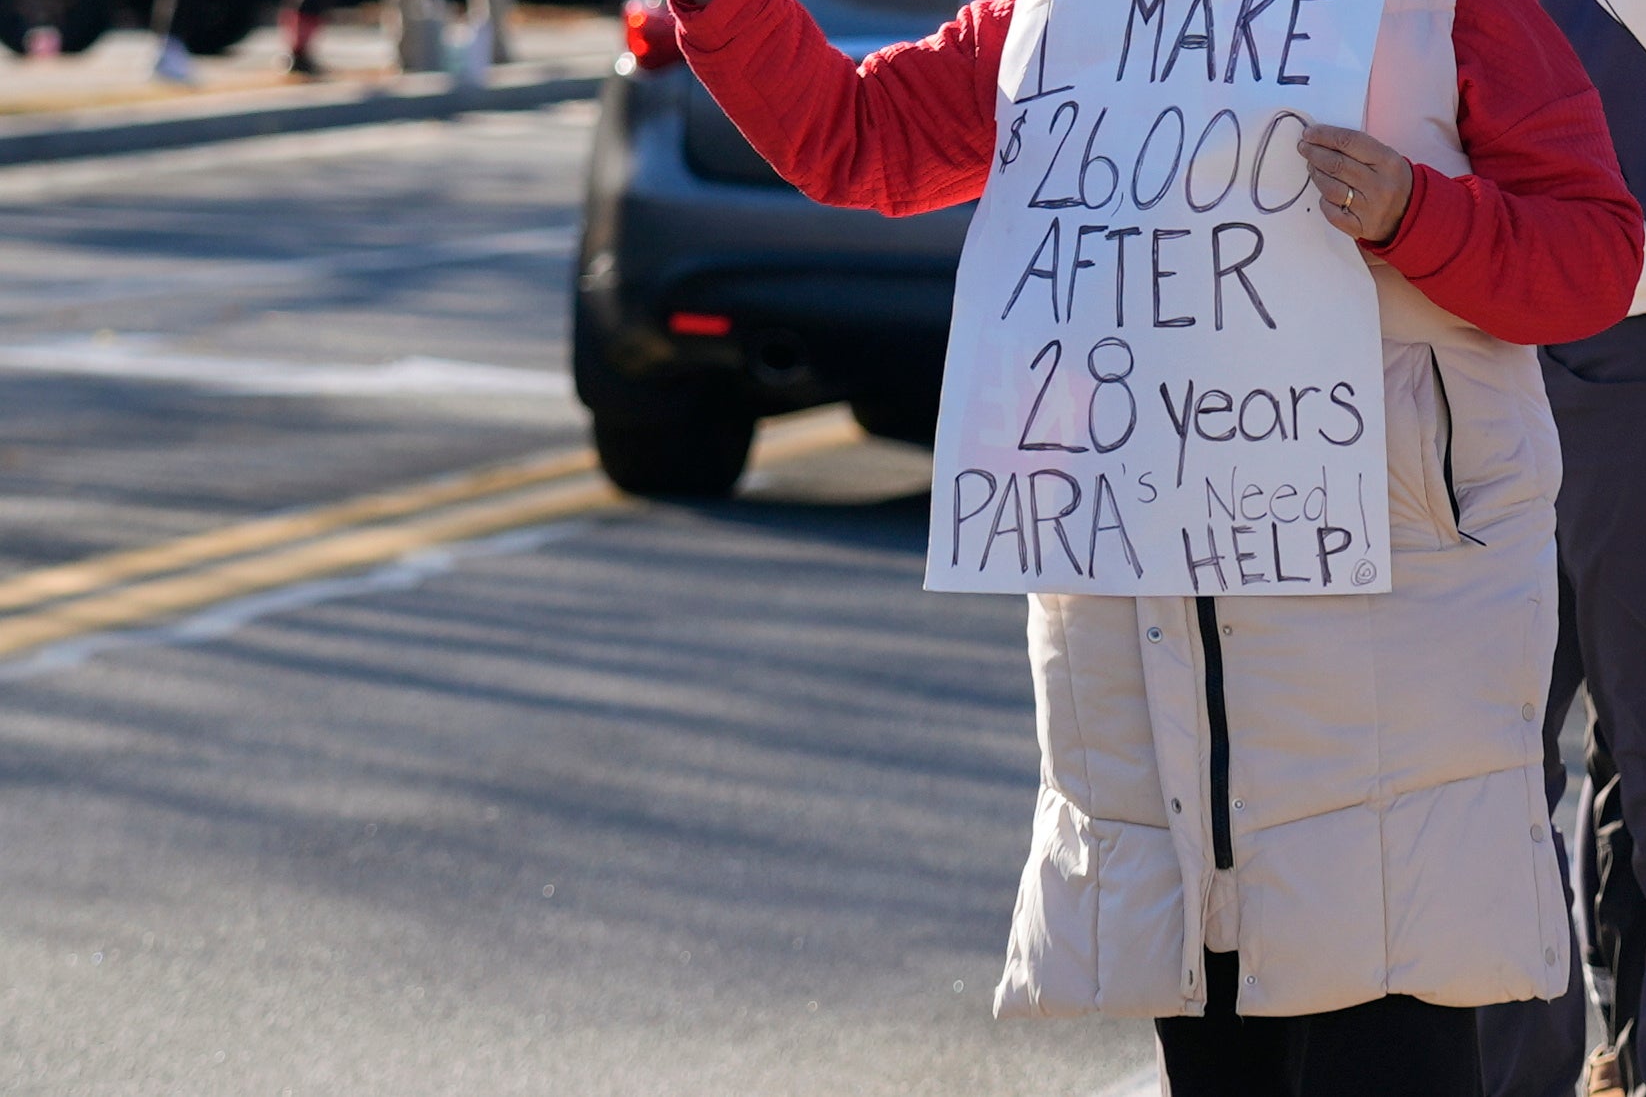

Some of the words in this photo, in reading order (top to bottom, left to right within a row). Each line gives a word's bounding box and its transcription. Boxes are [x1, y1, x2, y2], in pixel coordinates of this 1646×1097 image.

[1001, 216, 1277, 330] AFTER
[1018, 336, 1137, 454] 28
[1160, 379, 1365, 488] years
[952, 463, 1158, 579] PARA's
[1205, 465, 1328, 524] Need
